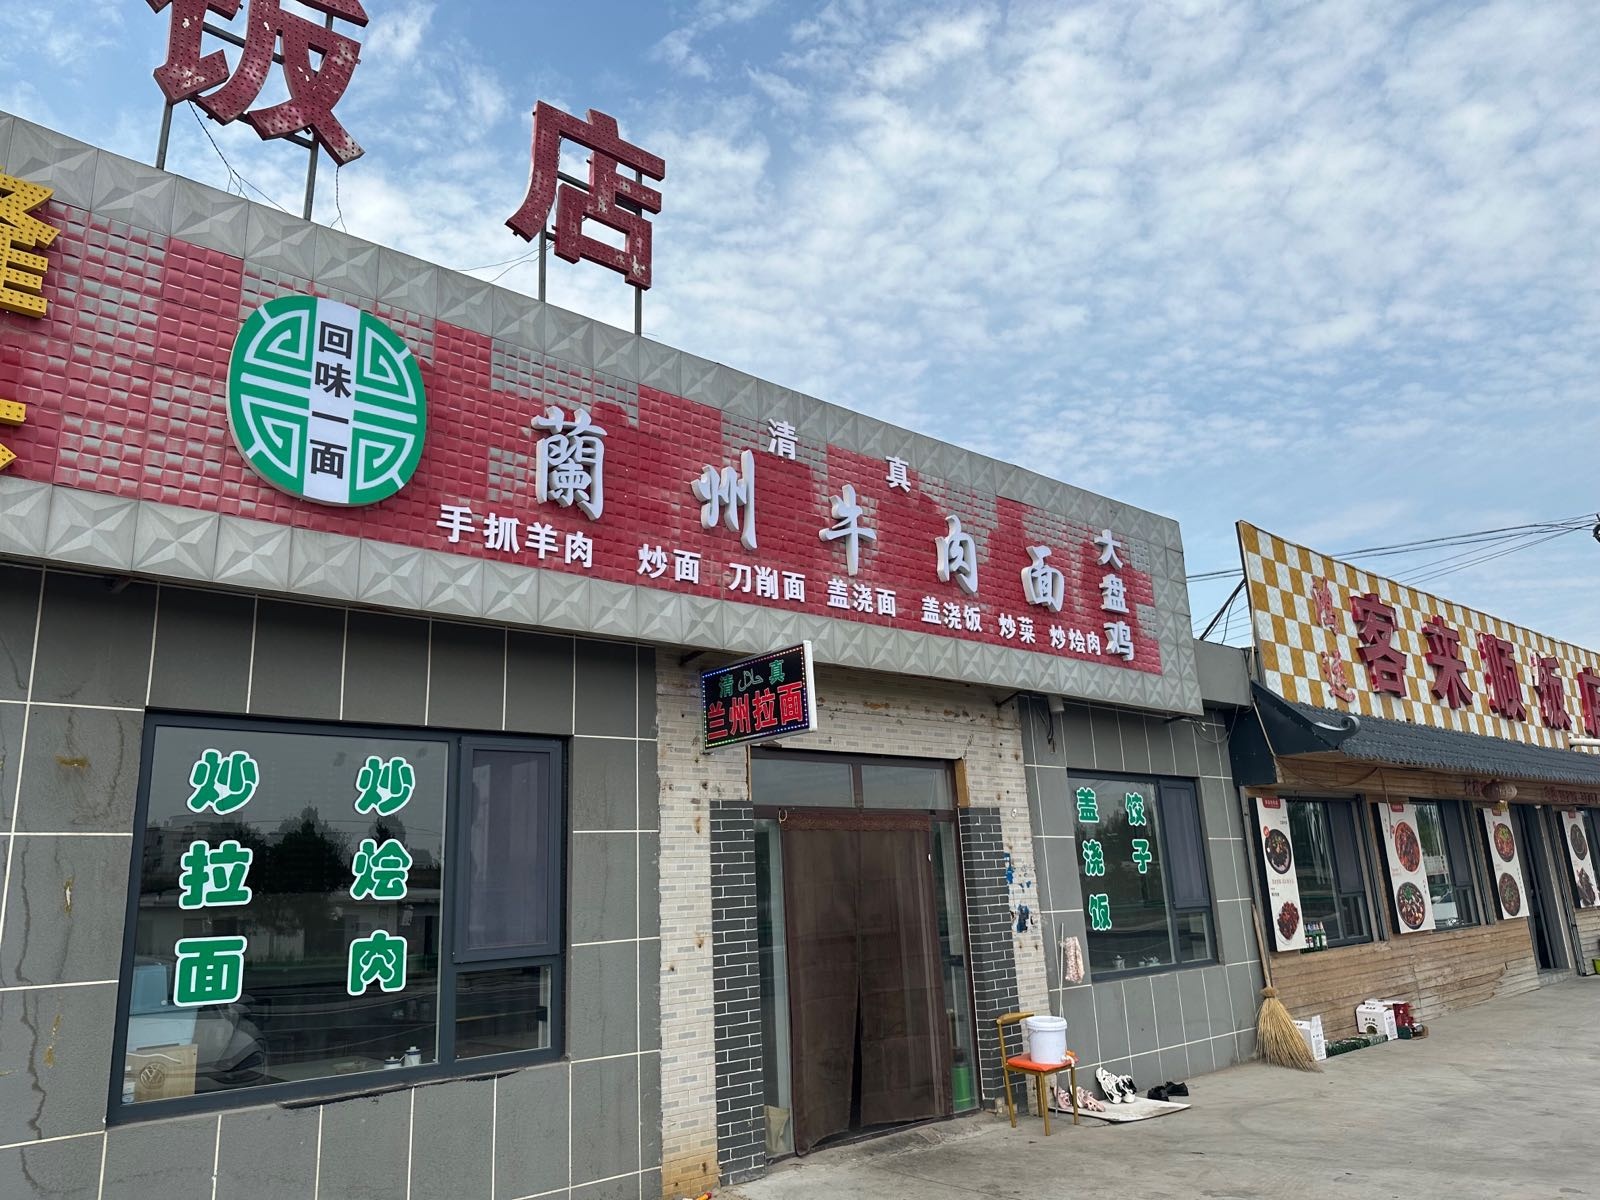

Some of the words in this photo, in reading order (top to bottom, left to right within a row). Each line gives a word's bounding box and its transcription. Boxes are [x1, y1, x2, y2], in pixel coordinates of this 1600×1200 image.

[309, 320, 353, 479] 回味一面
[436, 504, 594, 568] 手抓羊肉
[637, 543, 702, 585] 炒面
[727, 561, 806, 603] 刀削面
[827, 577, 897, 618] 盖浇面
[920, 595, 983, 633] 盖浇饭
[998, 613, 1036, 645] 炒菜
[1049, 624, 1102, 656] 炒烩肉
[1093, 528, 1135, 662] 大盘鸡
[707, 680, 803, 740] 兰州拉面
[173, 748, 260, 1007] 炒拉面
[347, 755, 416, 996] 炒烩肉
[1076, 786, 1113, 932] 盖浇饭
[1124, 791, 1153, 875] 饺子
